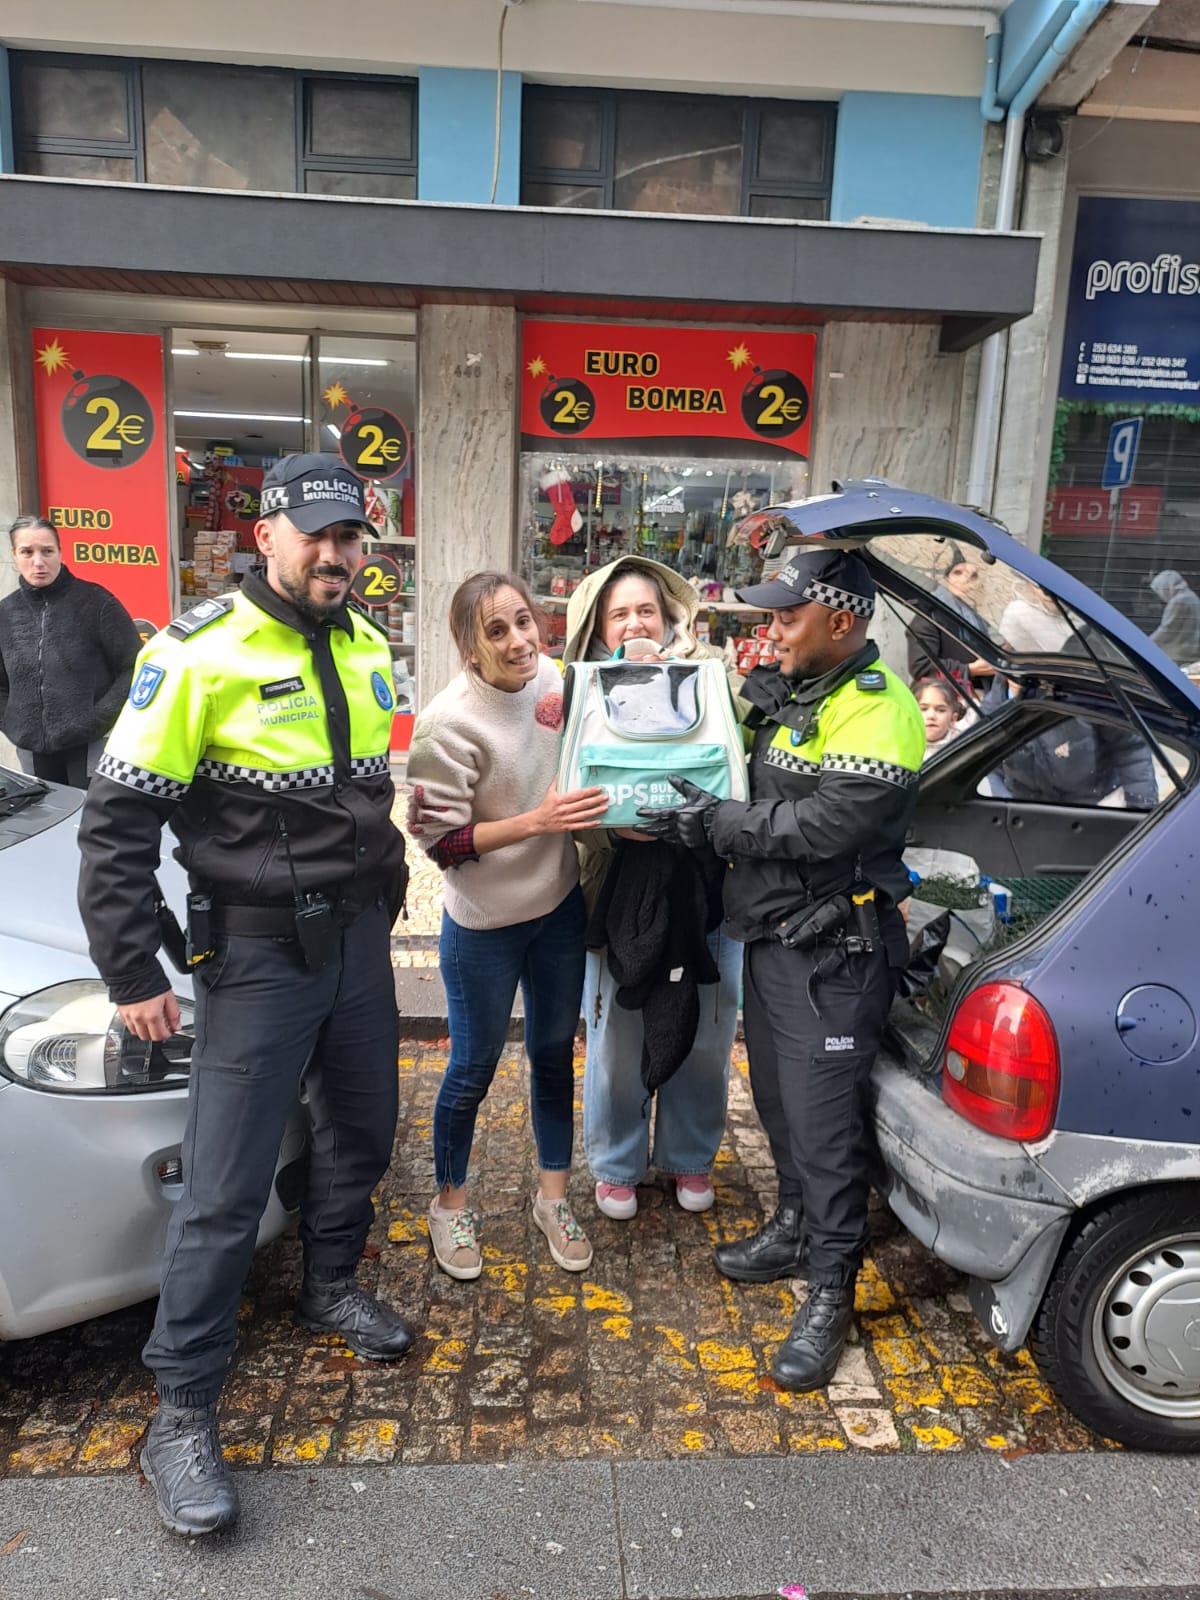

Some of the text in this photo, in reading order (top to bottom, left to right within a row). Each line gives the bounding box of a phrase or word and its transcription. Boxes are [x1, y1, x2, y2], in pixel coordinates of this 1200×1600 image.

[1086, 254, 1200, 300] profis
[585, 350, 660, 377] EURO
[553, 390, 590, 424] 2€
[626, 386, 726, 414] BOMBA
[756, 385, 802, 425] 2€
[85, 397, 145, 451] 2€
[357, 424, 401, 465] 2€
[302, 478, 360, 498] POLÍCIA
[303, 491, 360, 506] MUNICIPAL
[48, 507, 111, 530] EURO
[74, 542, 159, 567] BOMBA
[363, 566, 397, 596] 2€
[256, 694, 317, 714] POLÍCIA
[260, 710, 320, 727] MUNICIPAL
[650, 794, 687, 805] PET S
[825, 1035, 855, 1045] POLÍCIA
